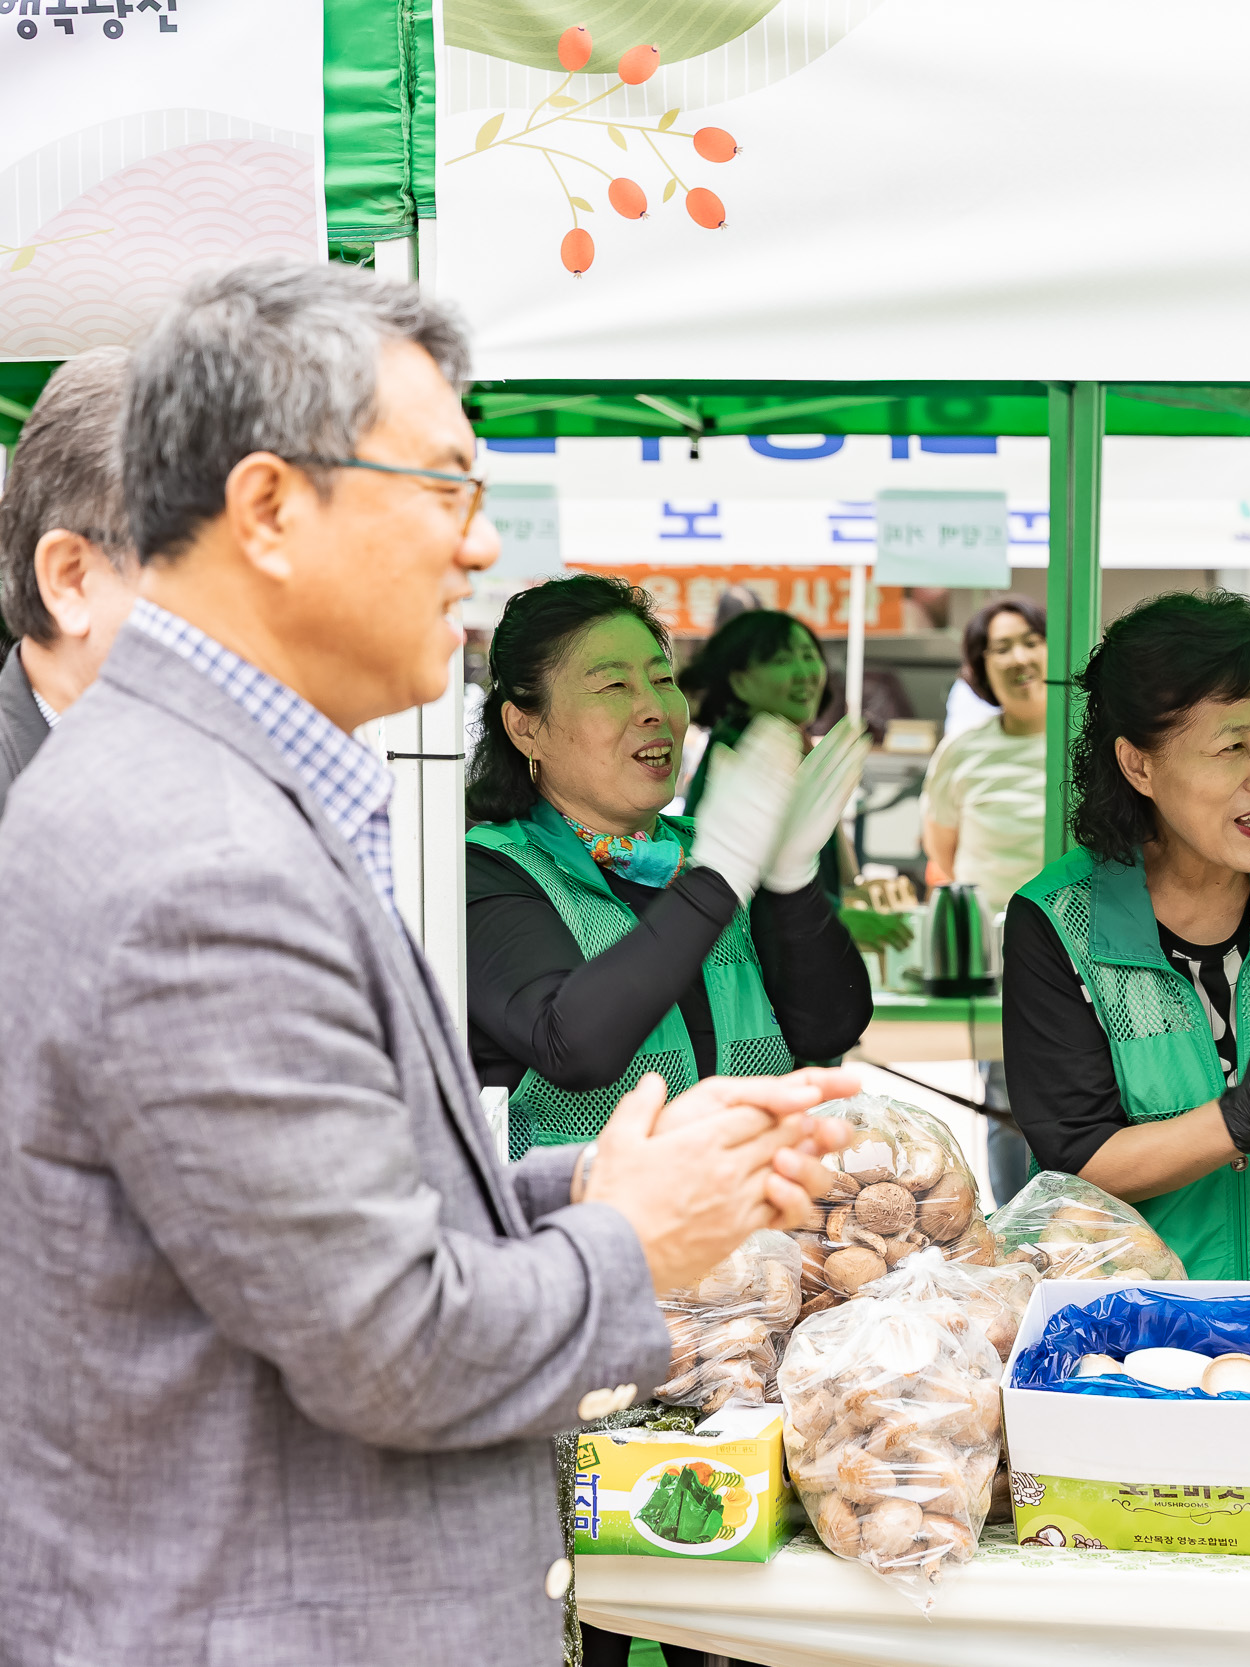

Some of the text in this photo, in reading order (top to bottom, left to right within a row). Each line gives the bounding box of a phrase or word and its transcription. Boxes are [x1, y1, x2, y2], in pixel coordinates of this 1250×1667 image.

[1154, 1501, 1209, 1509] MUSHROOMS
[1133, 1534, 1238, 1547] 호산목장 영농조합법인
